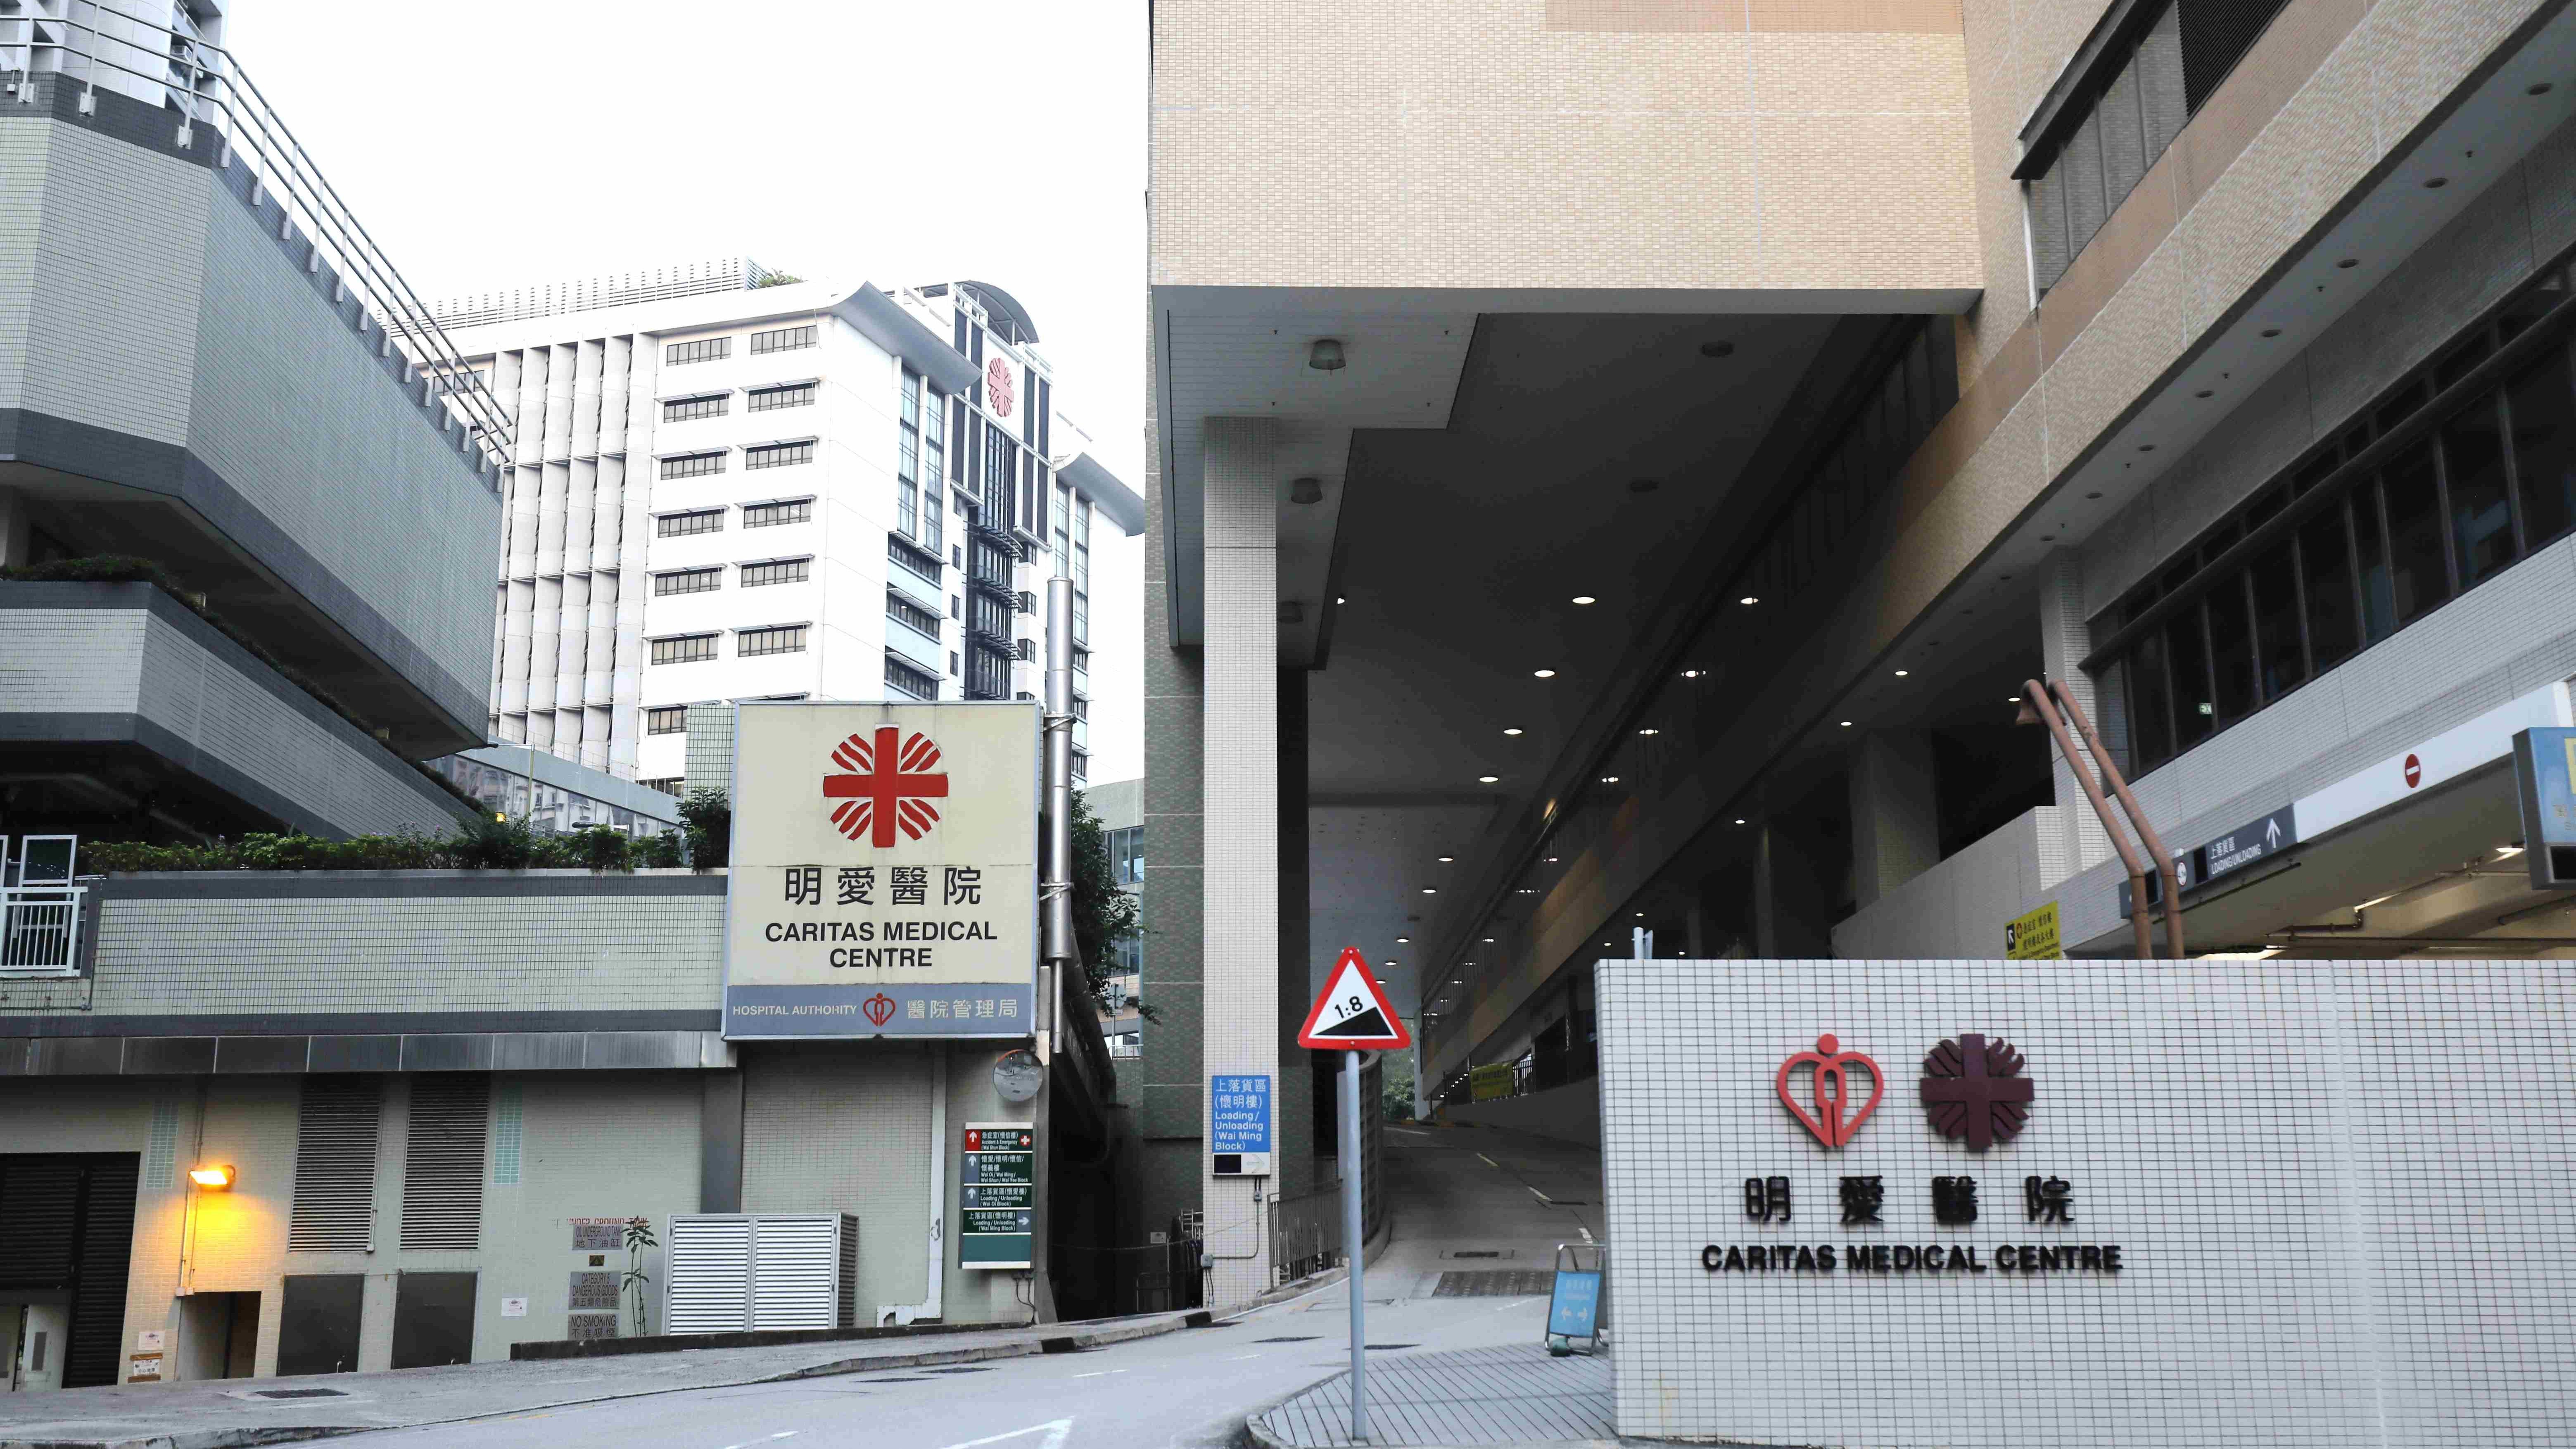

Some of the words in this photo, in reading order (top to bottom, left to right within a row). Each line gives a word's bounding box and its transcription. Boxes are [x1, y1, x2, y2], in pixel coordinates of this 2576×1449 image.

[2211, 843, 2261, 874] LOADING/UNLOADING
[785, 867, 981, 905] 明愛醫院
[765, 922, 874, 942] CARITAS
[883, 921, 997, 941] MEDICAL
[830, 948, 932, 968] CENTRE
[733, 1005, 789, 1016] HOSPITAL
[792, 1004, 857, 1015] AUTHORITY
[907, 999, 1018, 1019] 醫院管理局
[1335, 996, 1363, 1019] 1:8
[1216, 1078, 1266, 1092] 上落貨區
[1216, 1112, 1253, 1121] Loading
[1216, 1121, 1263, 1131] Unloading
[1215, 1132, 1236, 1140] (Wai
[1239, 1132, 1262, 1141] Ming
[1216, 1142, 1245, 1151] Block)
[1745, 1175, 2074, 1223] 明愛醫院
[576, 1238, 620, 1248] 地下油缸
[1701, 1244, 1837, 1272] CARITAS
[1847, 1245, 1987, 1271] MEDICAL
[1996, 1244, 2123, 1271] CENTRE
[582, 1273, 606, 1284] CATEGORY
[607, 1273, 610, 1284] 5
[572, 1285, 601, 1296] DANGEROUS
[601, 1285, 618, 1296] GOODS
[571, 1316, 582, 1327] NO
[583, 1315, 616, 1327] SMOKING
